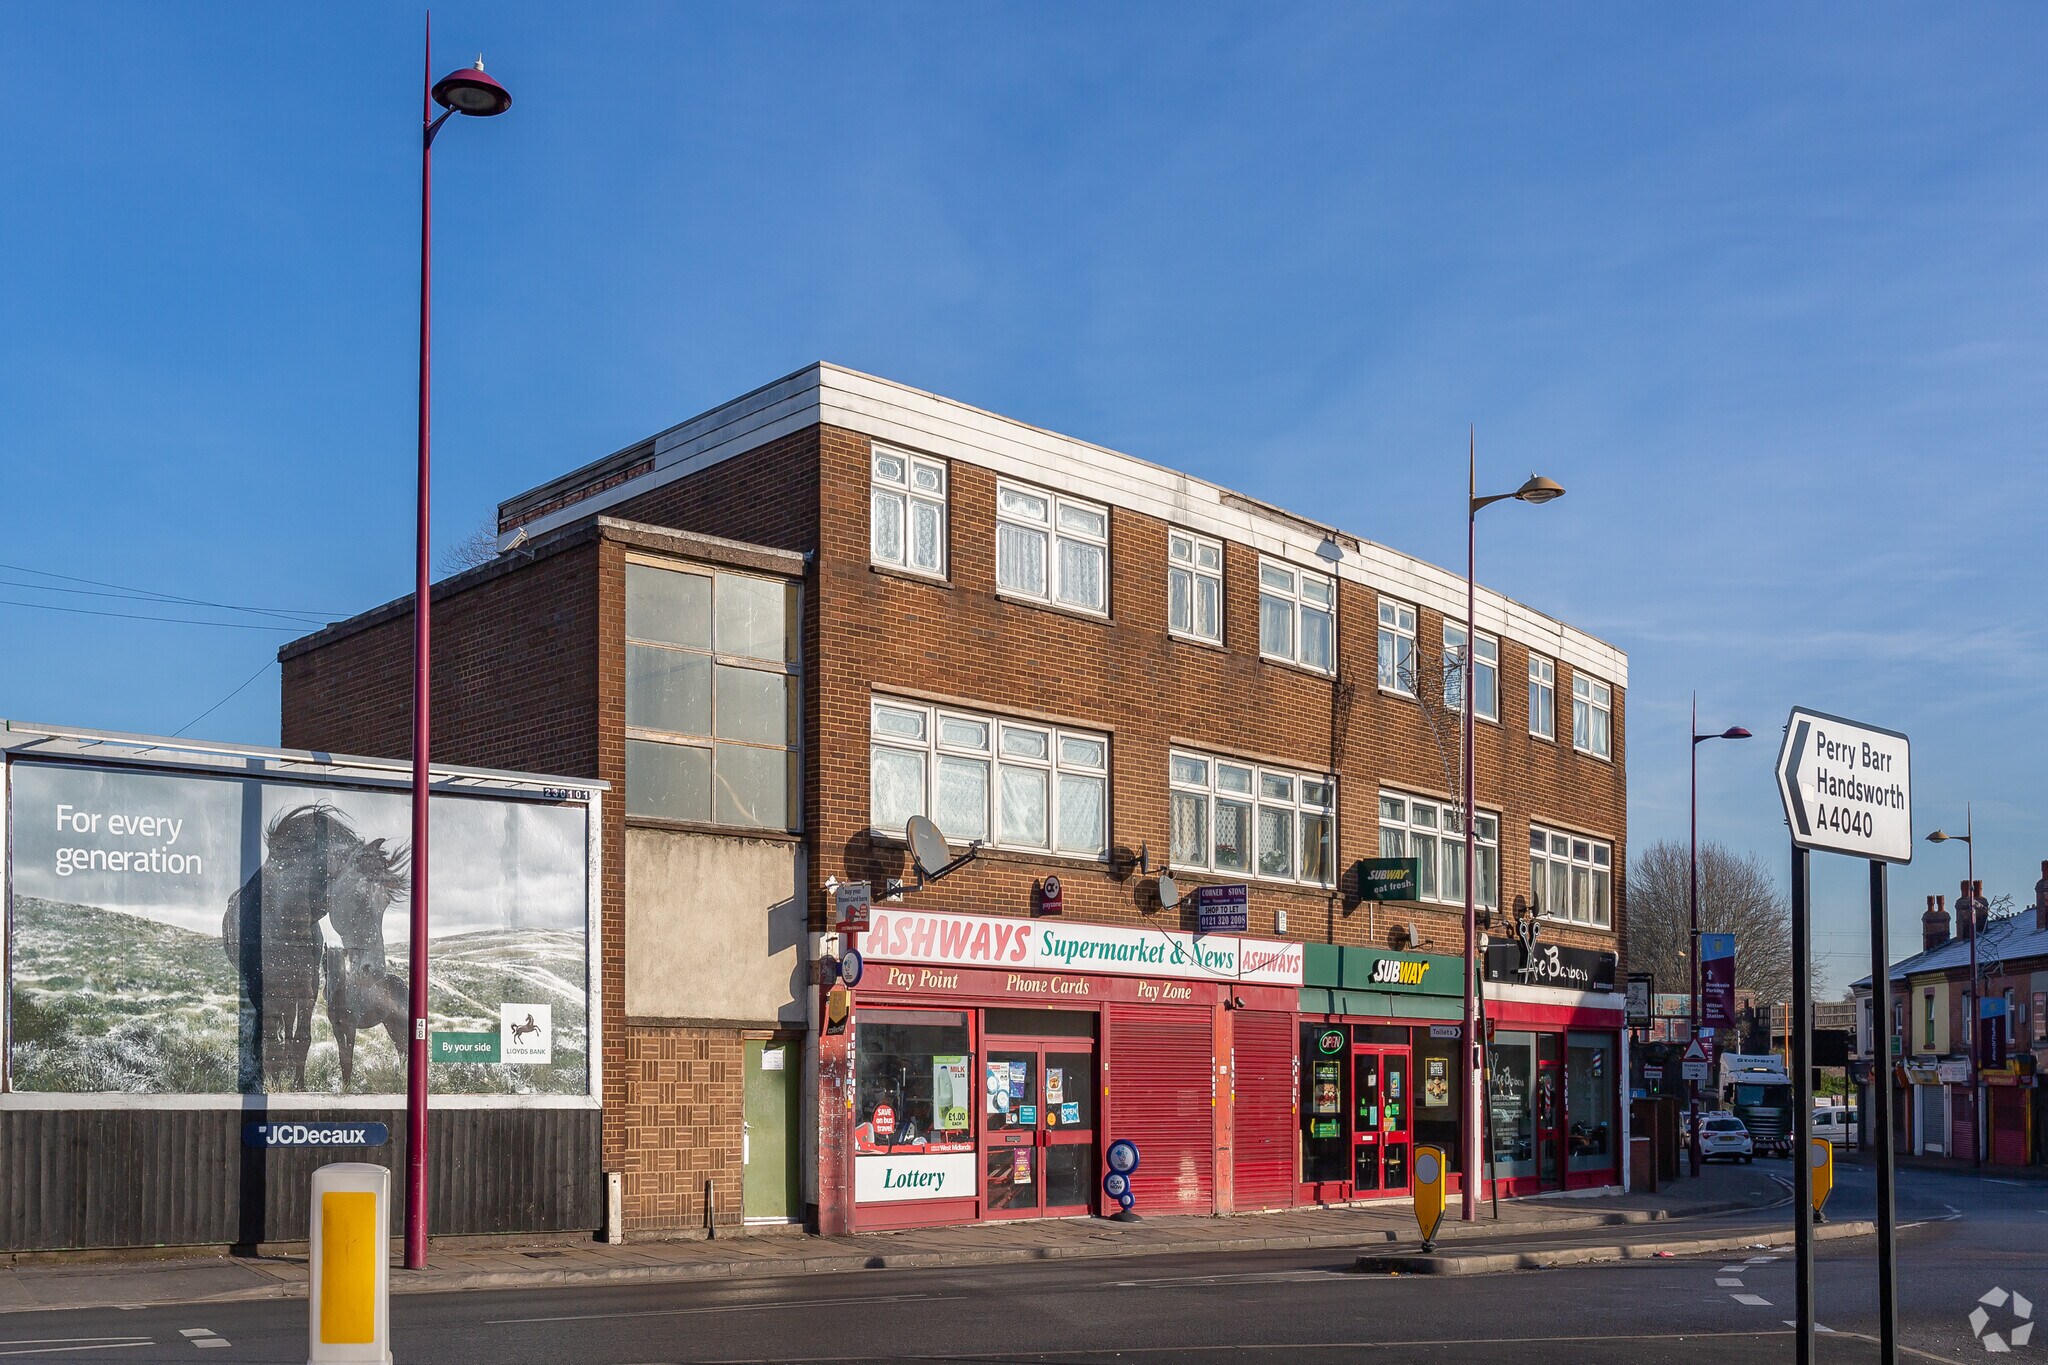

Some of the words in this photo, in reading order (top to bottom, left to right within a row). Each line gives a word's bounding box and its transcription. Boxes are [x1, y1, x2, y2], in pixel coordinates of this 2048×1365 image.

[1816, 730, 1856, 770] Perry
[1862, 741, 1892, 773] Barr
[545, 788, 588, 799] 230101
[1816, 766, 1905, 810] Handsworth
[56, 804, 101, 833] For
[108, 814, 183, 845] every
[1816, 803, 1873, 838] A4040
[55, 846, 202, 877] generation
[1367, 869, 1409, 880] SUBWAY
[1201, 888, 1224, 897] CORNER
[1228, 887, 1246, 896] STONE
[1374, 884, 1387, 894] eat
[1389, 879, 1414, 891] fresh.
[1205, 906, 1219, 914] SHOP
[1220, 906, 1228, 914] TO
[1229, 905, 1239, 913] LET
[1201, 916, 1216, 926] 0121
[1217, 915, 1229, 925] 320
[1230, 915, 1246, 924] 2008
[866, 914, 1032, 962] ASHWAYS
[1040, 929, 1165, 965] Supermarket
[1169, 942, 1186, 965] &
[1190, 942, 1235, 970] News
[1242, 950, 1301, 974] ASHWAYS
[1373, 959, 1430, 984] SUBWAY
[1543, 945, 1588, 981] Barbers
[887, 967, 916, 990] Pay
[918, 969, 958, 989] Point
[1006, 973, 1048, 993] Phone
[1050, 976, 1090, 995] Cards
[1137, 981, 1160, 1002] Pay
[1161, 982, 1192, 999] Zone
[417, 1020, 425, 1029] 4
[417, 1029, 424, 1039] 8
[442, 1042, 453, 1053] By
[454, 1045, 473, 1053] your
[474, 1042, 492, 1052] side
[1321, 1036, 1341, 1049] OPEN
[877, 1108, 892, 1116] SAVE
[948, 1112, 966, 1121] £1.00
[1063, 1107, 1077, 1115] OPEN
[266, 1125, 366, 1145] JCDecaux
[883, 1168, 945, 1192] Lottery
